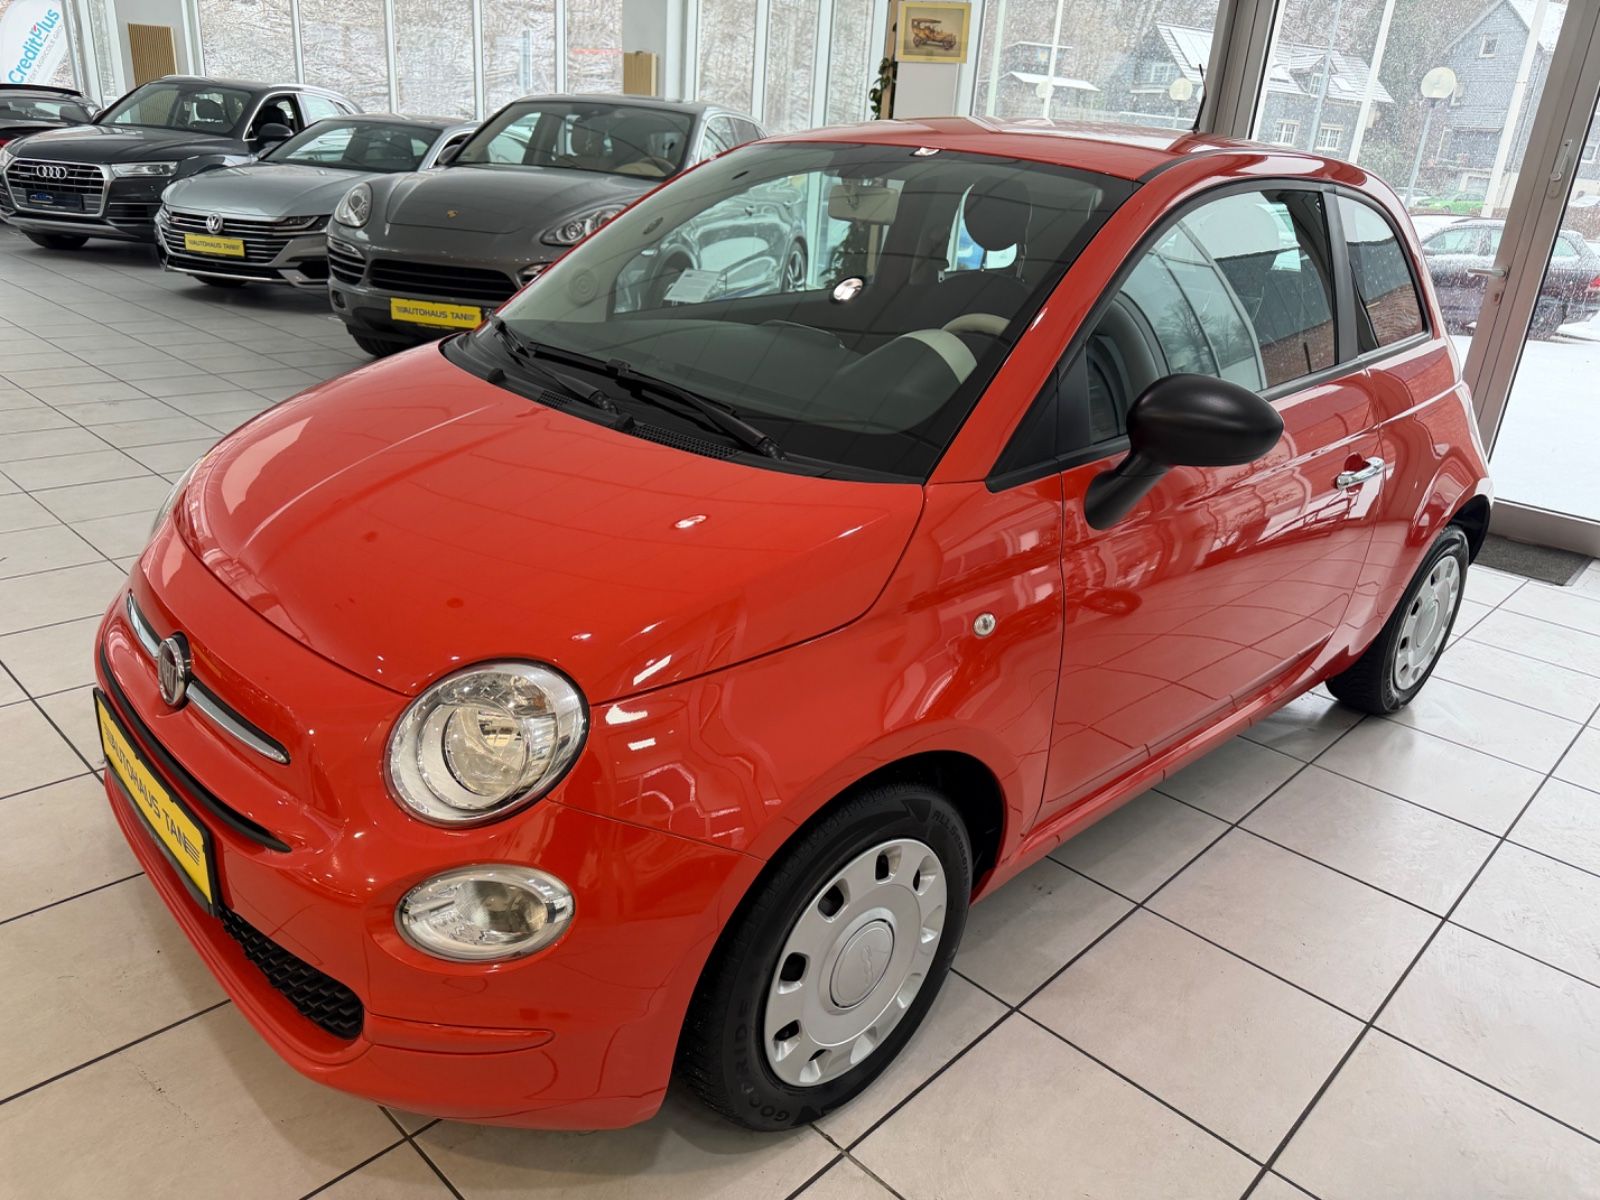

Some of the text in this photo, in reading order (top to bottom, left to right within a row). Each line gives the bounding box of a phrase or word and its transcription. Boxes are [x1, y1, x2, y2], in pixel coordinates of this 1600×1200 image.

[8, 9, 60, 83] CreditPlus
[192, 240, 222, 250] AUTOHAUS
[403, 306, 447, 319] AUTOHAUS
[111, 736, 160, 819] AUTOHAUS
